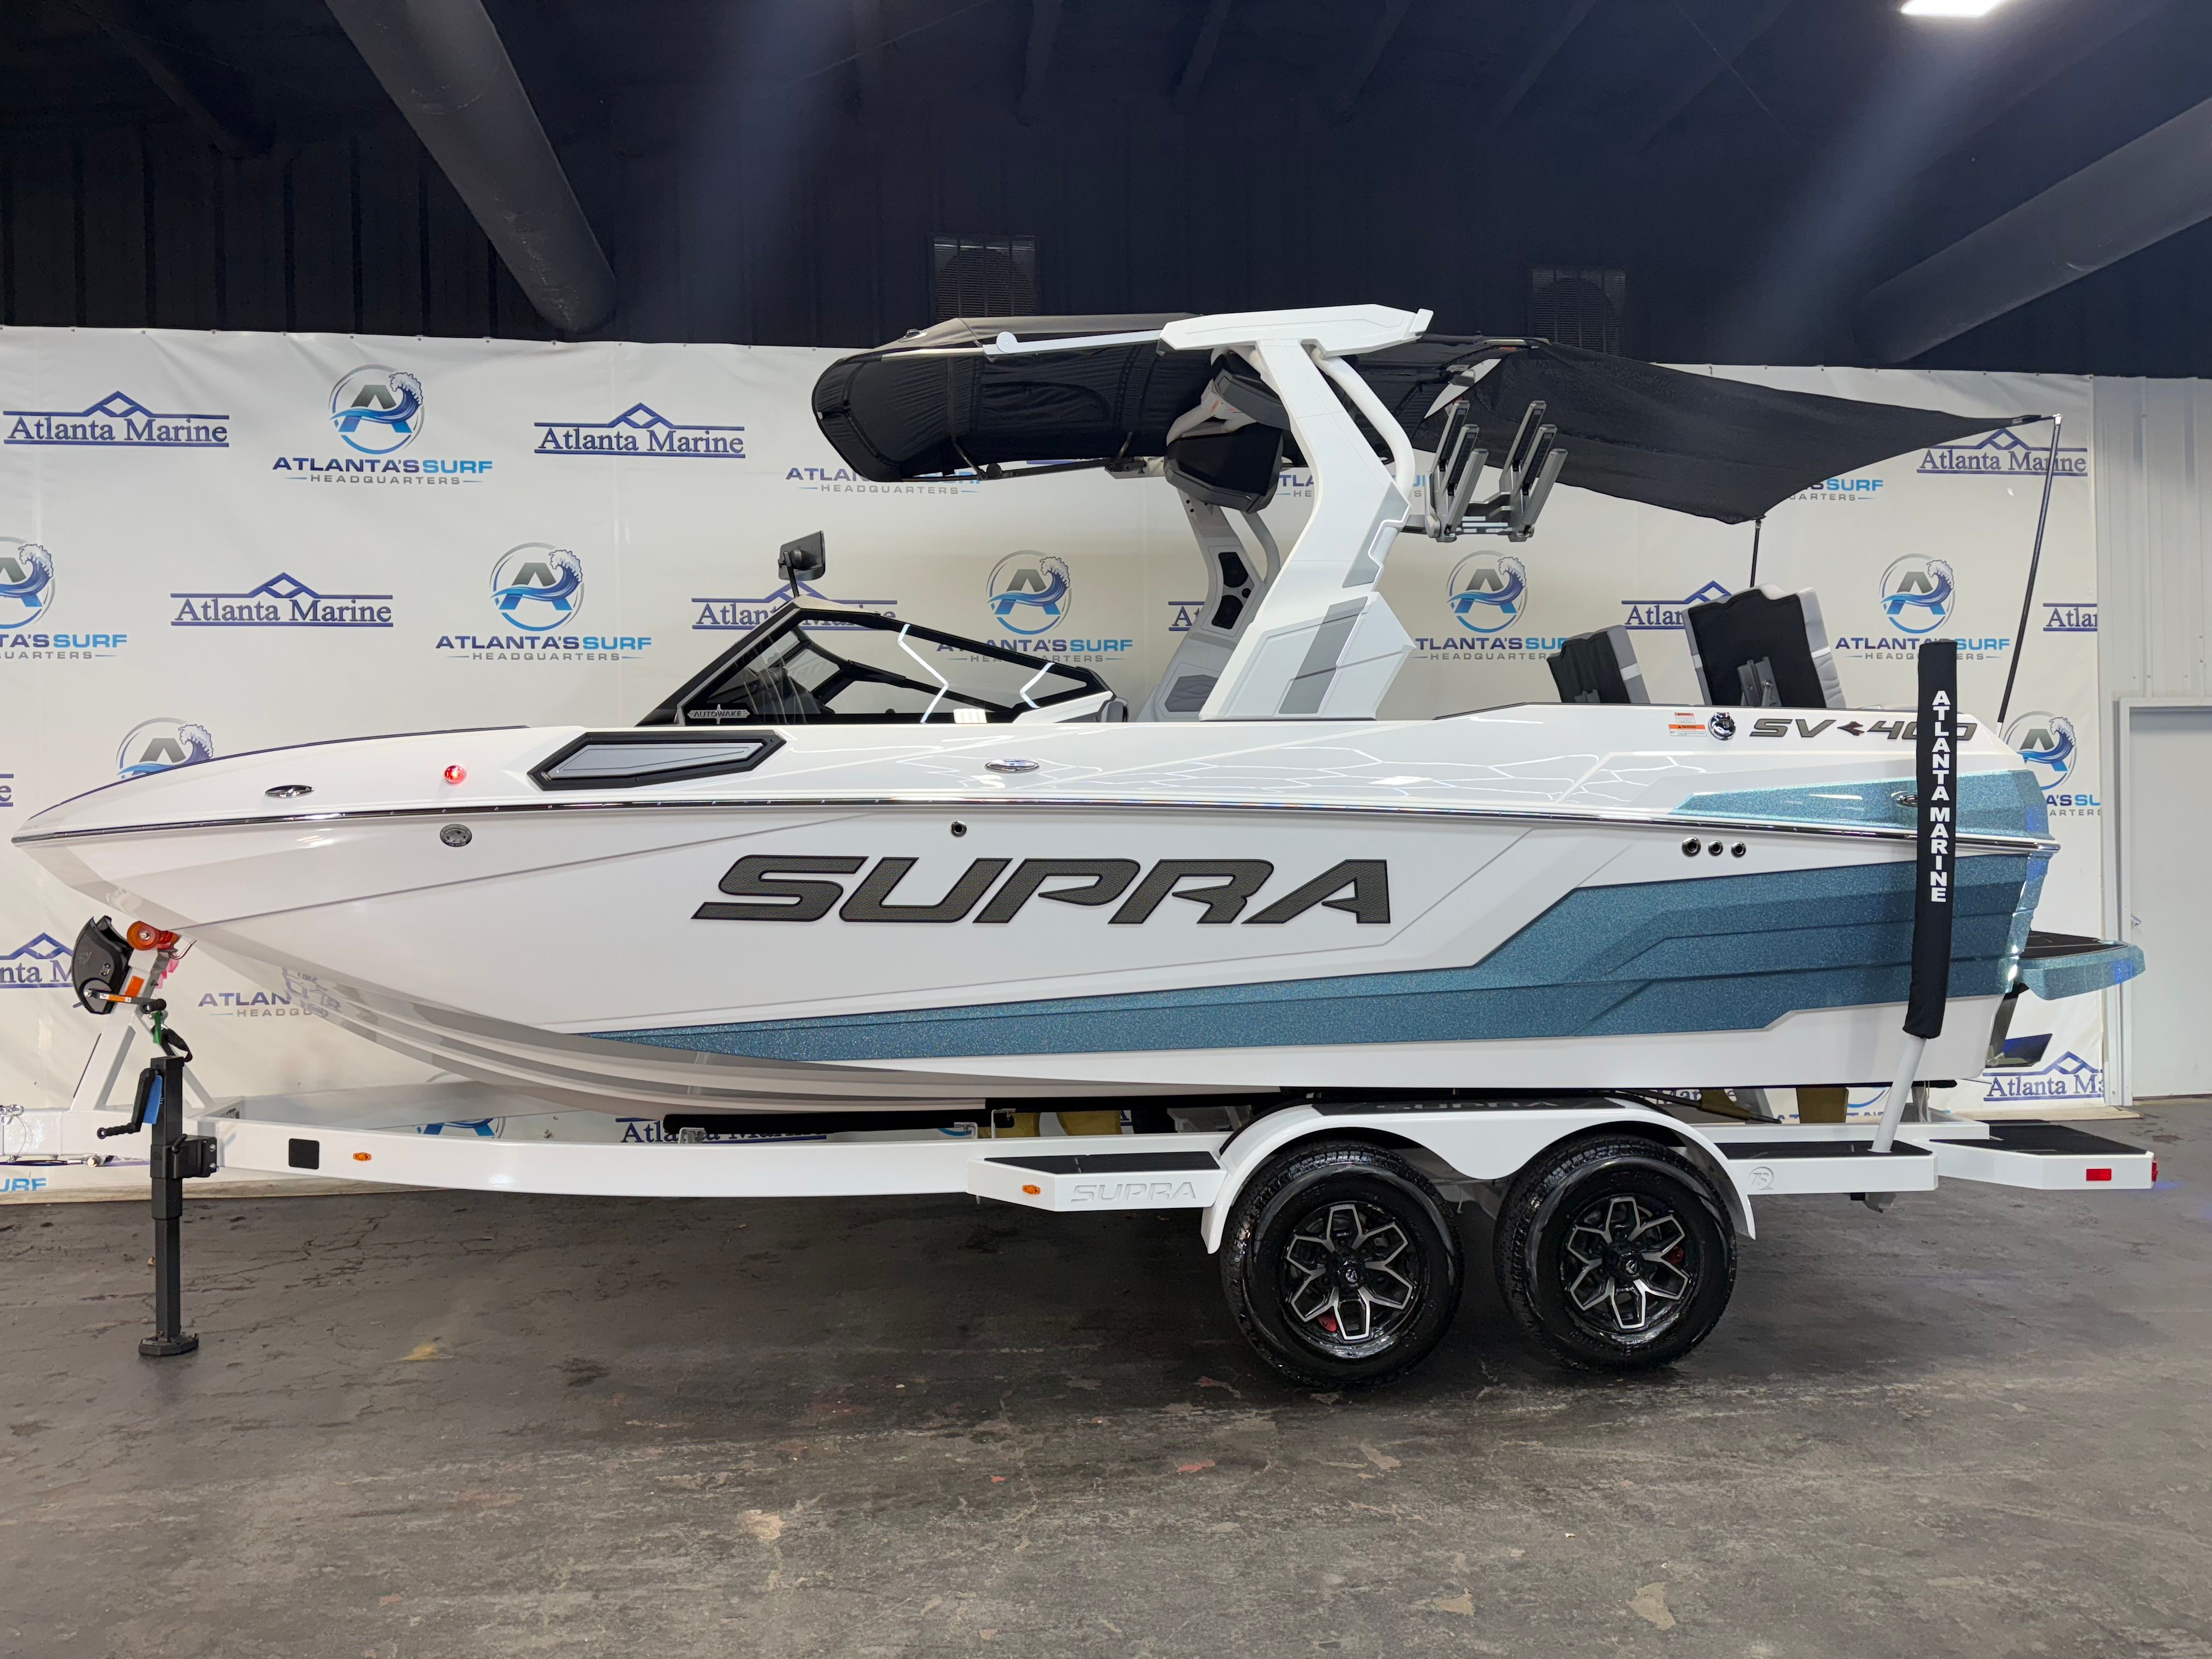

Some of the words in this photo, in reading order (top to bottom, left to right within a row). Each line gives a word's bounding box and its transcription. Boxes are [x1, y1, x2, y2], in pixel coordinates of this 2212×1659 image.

[7, 416, 115, 441] Atlanta
[126, 419, 228, 442] Marine
[538, 427, 639, 450] Atlanta
[646, 430, 744, 453] Marine
[1919, 449, 2001, 469] Atlanta
[311, 475, 460, 484] HEADQUARTERS
[821, 484, 958, 494] HEADQUARTERS
[1827, 478, 1883, 491] SURF
[175, 598, 280, 621] Atlanta
[289, 599, 392, 622] Marine
[696, 603, 775, 625] Atlan
[1624, 604, 1684, 625] Atla
[2046, 607, 2097, 627] Atla
[936, 640, 1066, 652] AANTA'S
[1414, 637, 1522, 650] TLANTA'S
[473, 652, 619, 661] HEADQUARTERS
[1931, 690, 1951, 801] ATLANTA
[1930, 806, 1950, 902] MARINE
[691, 854, 1391, 924] SUPRA
[198, 992, 290, 1007] ATLAN
[1987, 1076, 2067, 1096] Atlanta
[0, 1177, 47, 1192] URF
[1071, 1182, 1197, 1203] SUPRA
